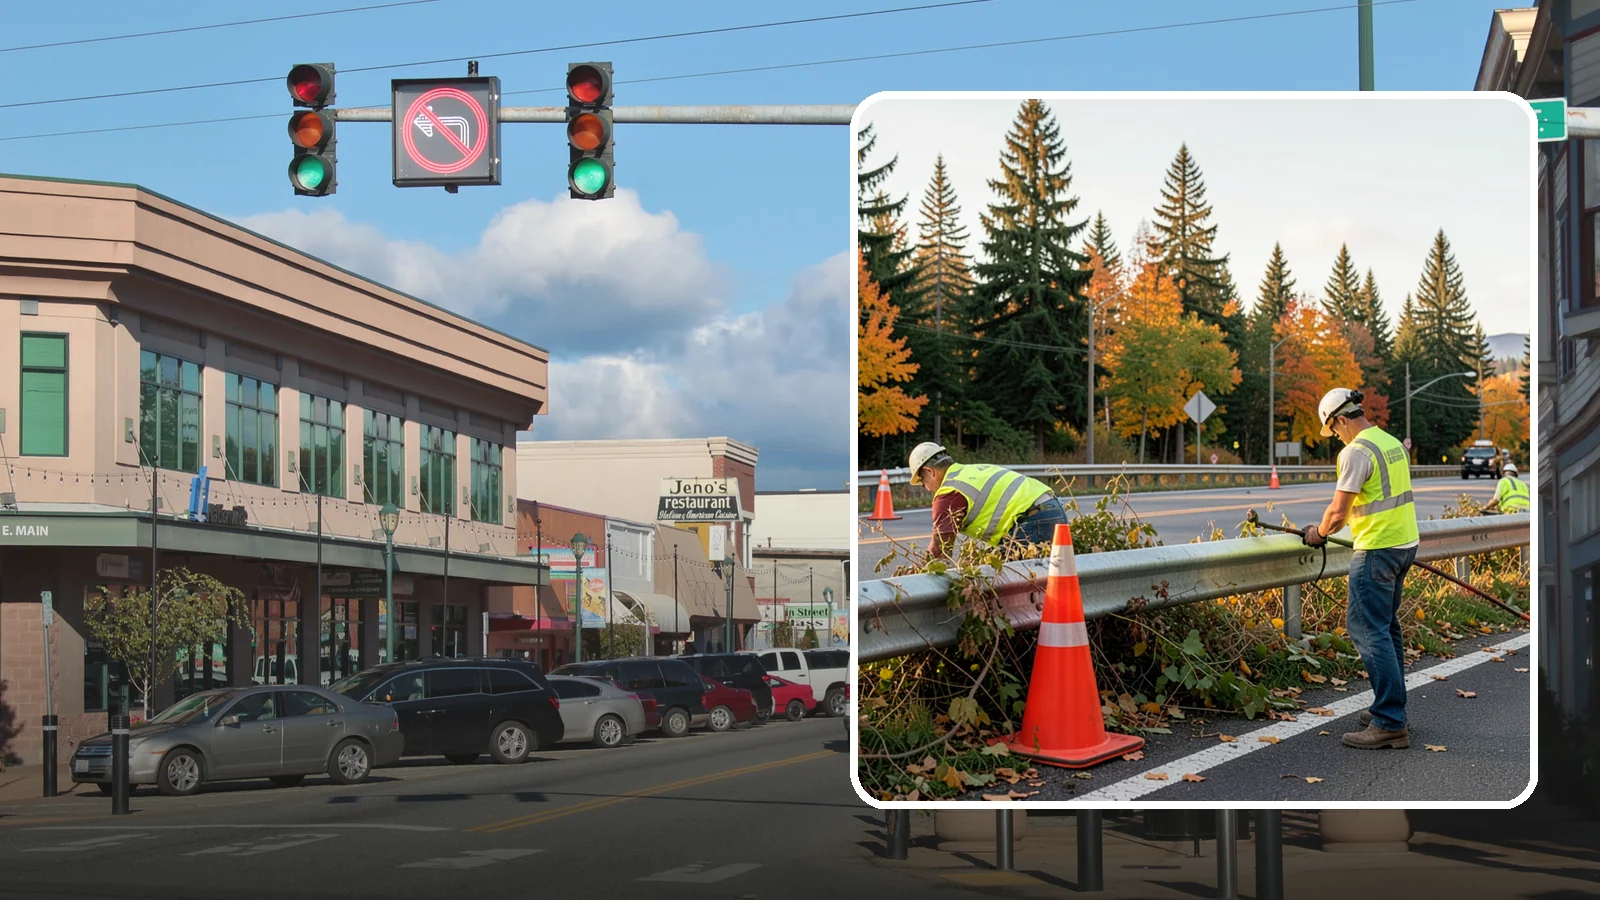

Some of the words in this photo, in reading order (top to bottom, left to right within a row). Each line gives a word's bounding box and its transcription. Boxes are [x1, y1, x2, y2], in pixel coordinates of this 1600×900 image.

[670, 480, 728, 494] Jeno's
[665, 497, 730, 509] restaurant
[659, 510, 681, 520] Italian
[685, 510, 714, 520] American
[715, 510, 737, 519] Cuisine
[2, 525, 13, 536] E.
[15, 525, 49, 536] MAIN
[797, 607, 828, 617] Street
